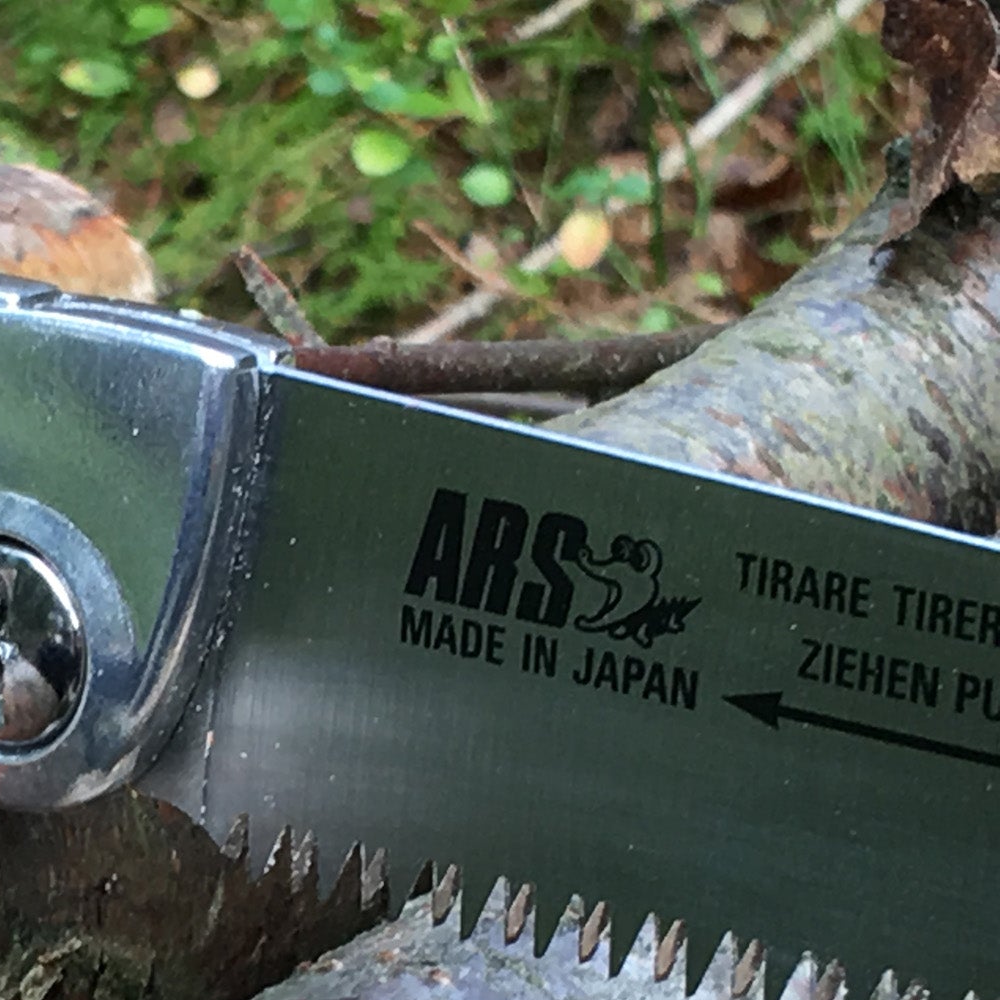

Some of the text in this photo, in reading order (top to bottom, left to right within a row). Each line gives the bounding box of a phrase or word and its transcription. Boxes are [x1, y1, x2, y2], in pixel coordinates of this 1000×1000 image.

[404, 488, 588, 628] ARS
[736, 552, 1000, 648] TIRARE TIRER
[400, 606, 699, 712] MADE IN JAPAN
[797, 638, 940, 707] ZIEHEN
